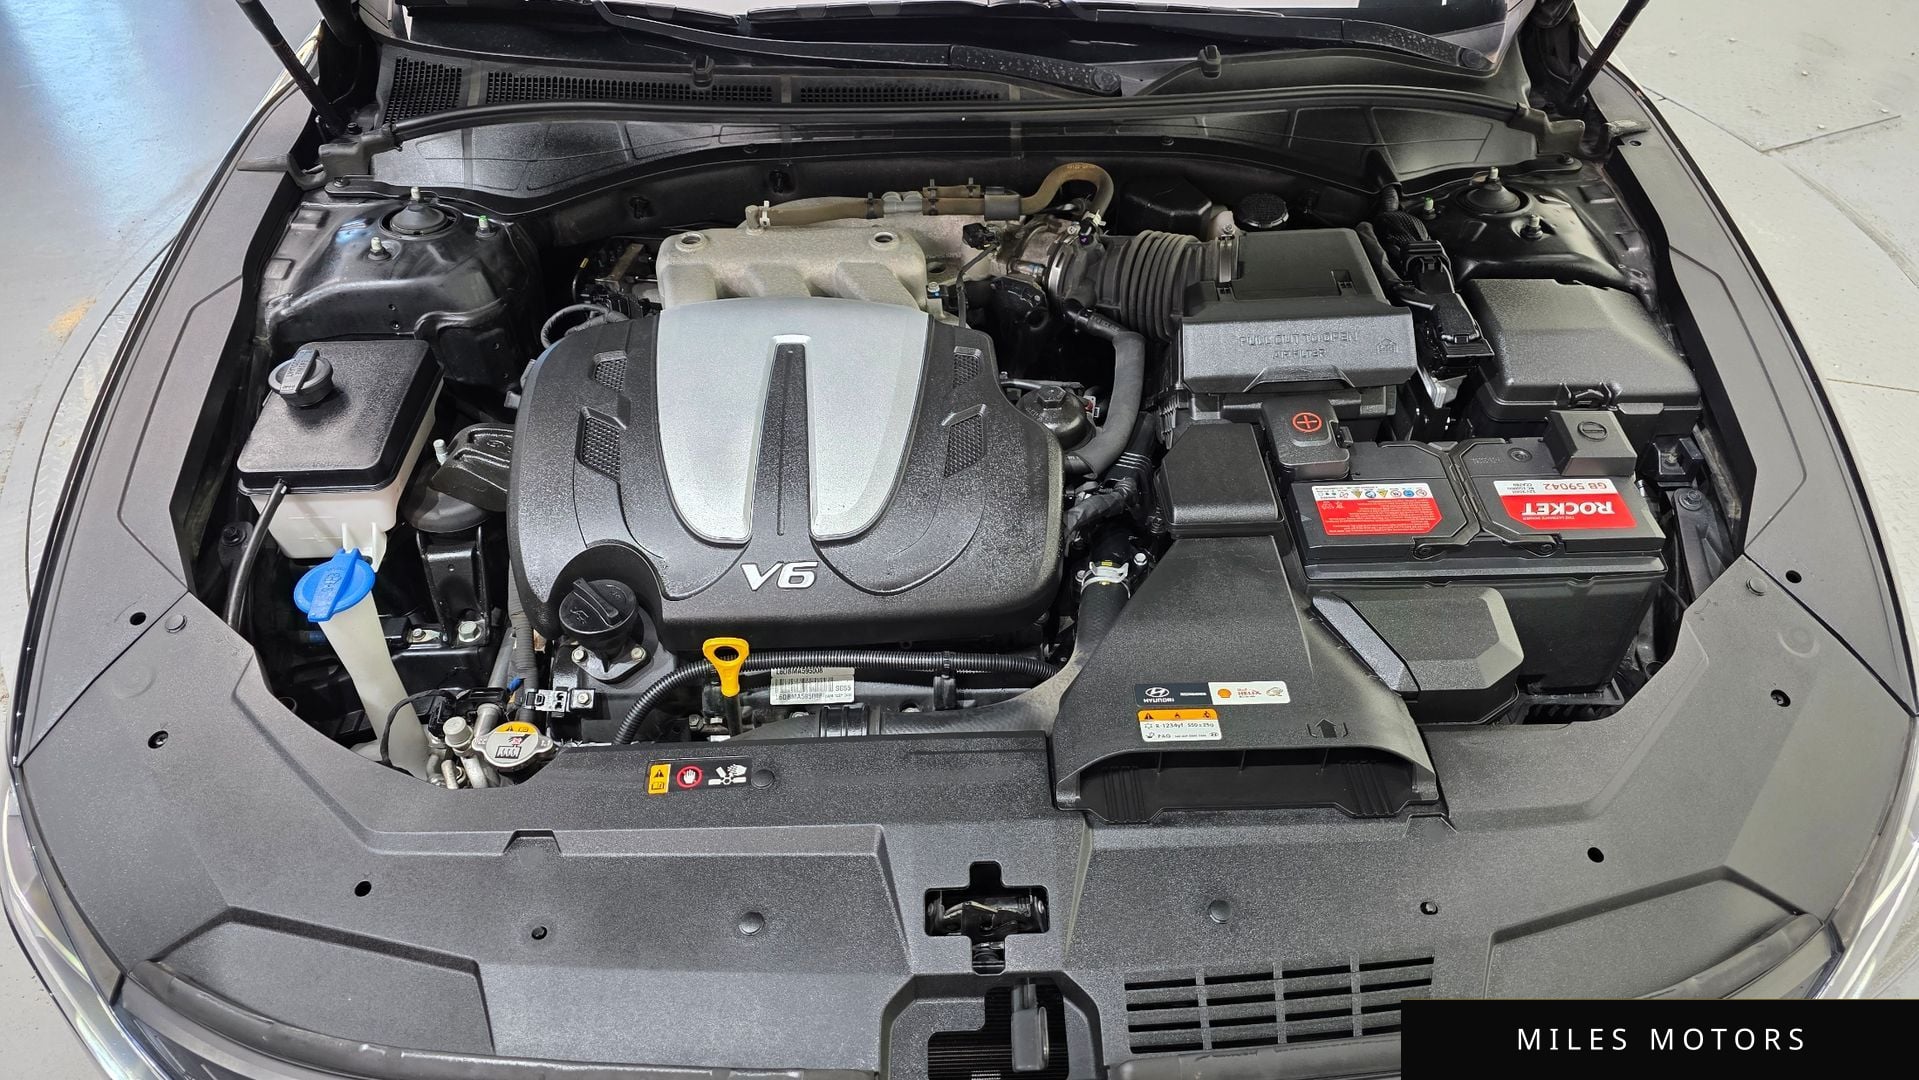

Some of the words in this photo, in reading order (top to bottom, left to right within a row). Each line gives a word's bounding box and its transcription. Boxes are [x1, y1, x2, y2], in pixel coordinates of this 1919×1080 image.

[1543, 482, 1585, 491] 59042
[1588, 482, 1607, 490] GB
[1521, 501, 1616, 516] ROCKET
[740, 561, 818, 591] V6
